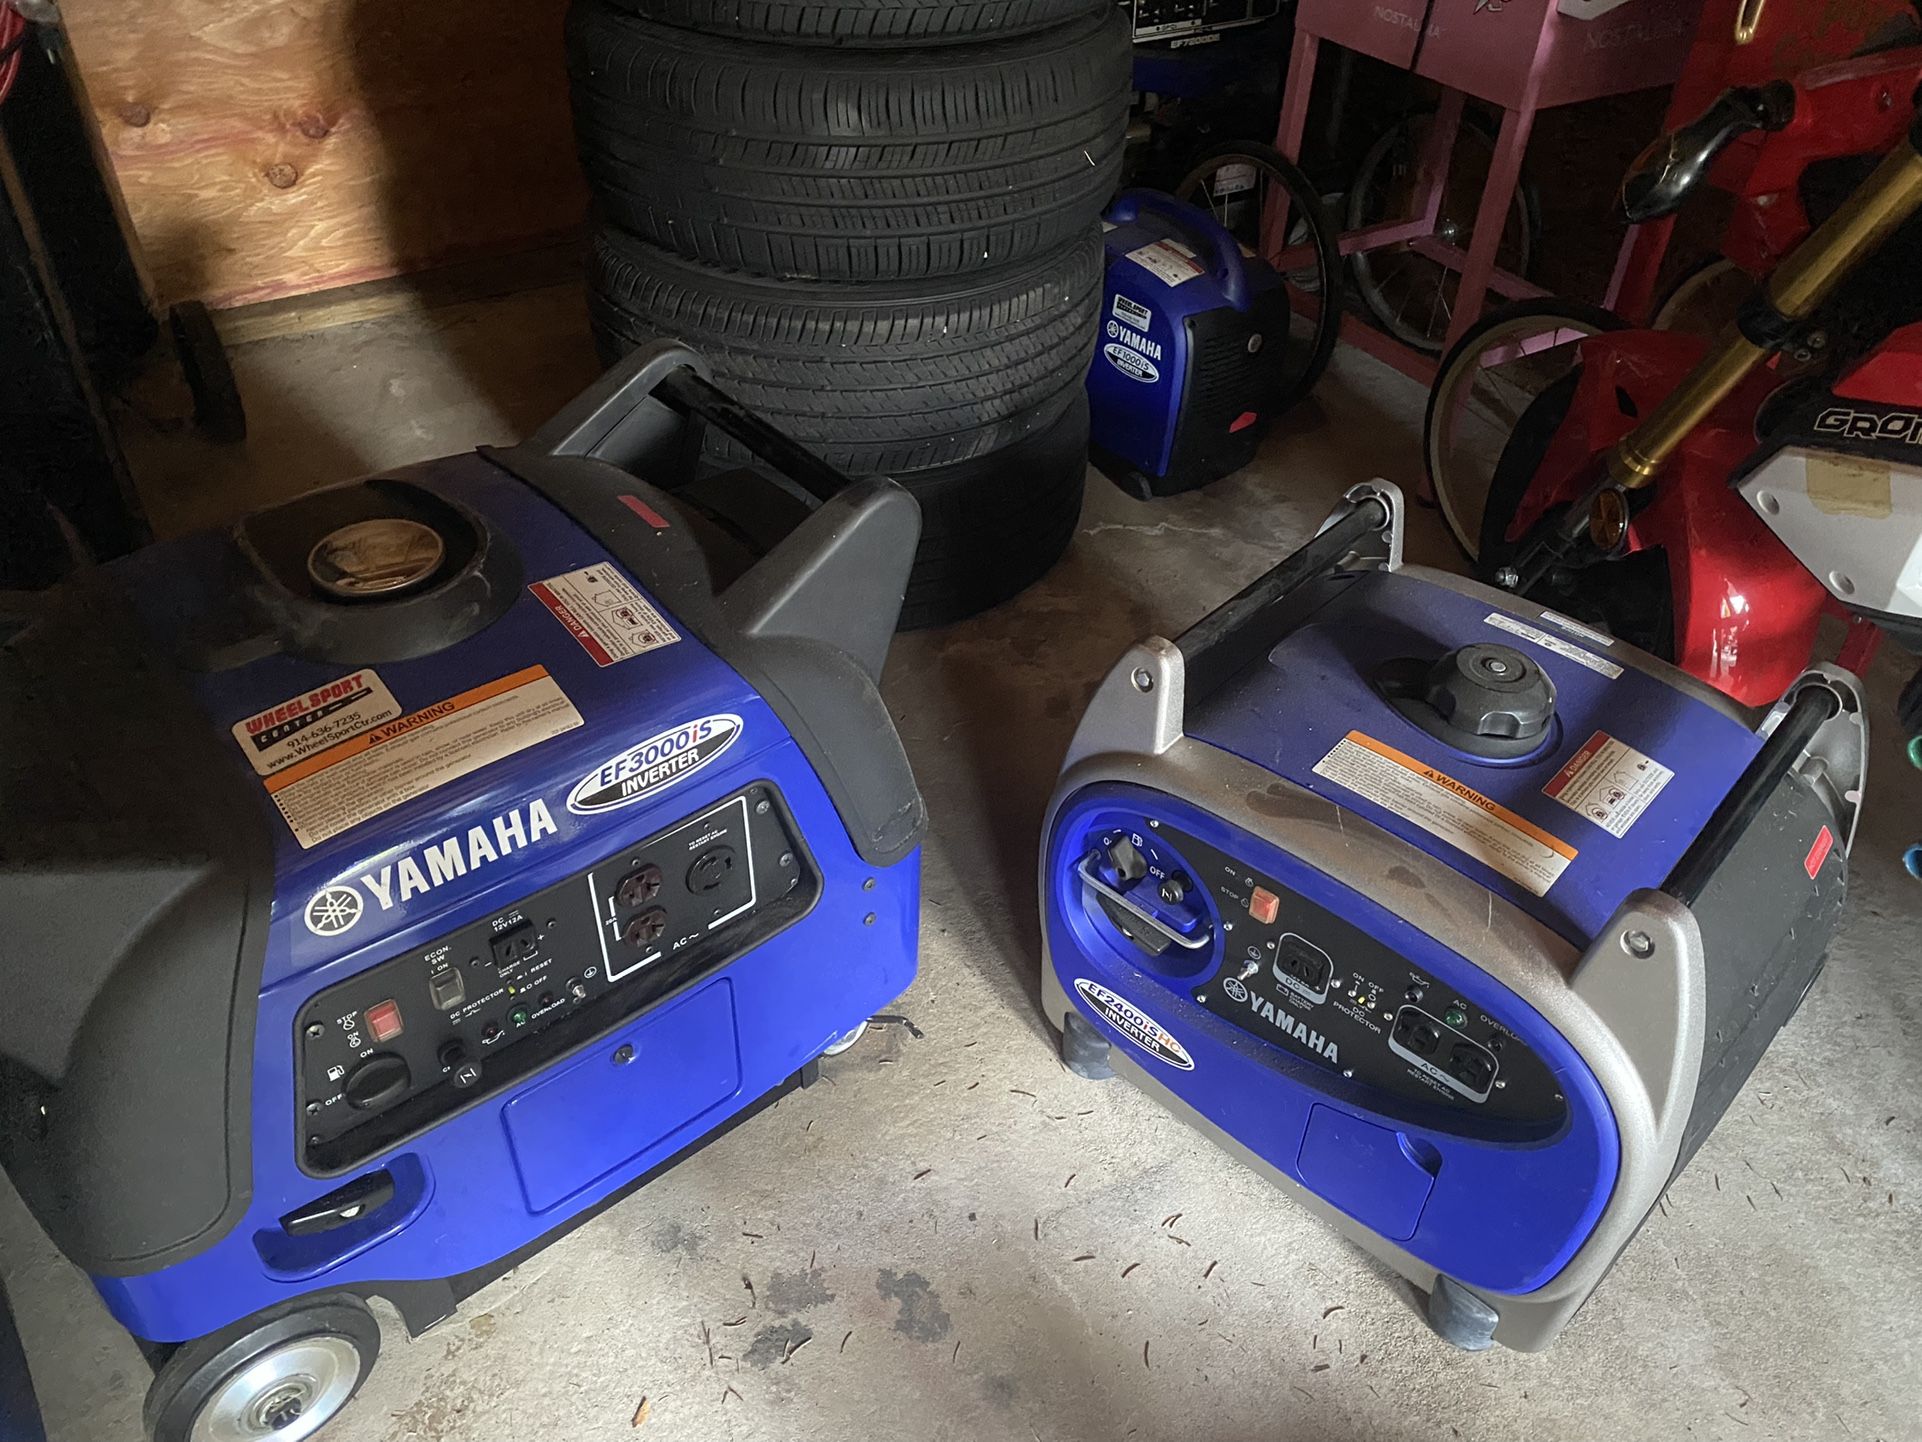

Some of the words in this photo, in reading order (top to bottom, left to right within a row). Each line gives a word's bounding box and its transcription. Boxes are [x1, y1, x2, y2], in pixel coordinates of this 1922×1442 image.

[1375, 6, 1440, 40] NOSTALIA
[1120, 326, 1161, 360] YAMAHA
[1113, 347, 1149, 370] EF1000iS
[1117, 359, 1143, 377] INVERTER
[554, 605, 580, 631] DANGER
[245, 698, 306, 734] WHEEL
[309, 674, 364, 709] SPORT
[260, 709, 327, 743] CENTER
[381, 701, 456, 738] WARNING
[287, 711, 361, 749] 914-636-7235
[267, 709, 393, 769] www.WheelSportCtr.com
[600, 720, 712, 786] EF3000iS
[621, 748, 699, 796] INVERTER
[1436, 774, 1497, 811] WARNING
[360, 798, 558, 910] YAMAHA
[1149, 866, 1166, 879] OFF
[1224, 866, 1236, 876] ON
[1220, 886, 1239, 899] STOP
[492, 917, 505, 927] DC
[672, 937, 687, 950] AC
[424, 945, 452, 962] ECON.
[431, 955, 445, 965] SW
[437, 963, 449, 971] ON
[498, 961, 521, 974] CHARGE
[530, 958, 553, 973] RESET
[499, 969, 514, 978] ONLY
[534, 975, 548, 986] OFF
[1352, 972, 1365, 982] ON
[1285, 978, 1300, 990] DC
[1368, 981, 1384, 993] OFF
[450, 1010, 461, 1020] DC
[463, 988, 504, 1013] PROTECTOR
[1352, 1006, 1365, 1017] DC
[1452, 999, 1467, 1010] AC
[336, 1011, 358, 1025] STOP
[1088, 984, 1181, 1053] EF2400iSHC
[1333, 1001, 1382, 1034] PROTECTOR
[347, 1031, 359, 1040] ON
[1105, 1007, 1160, 1052] INVERTER
[1249, 992, 1340, 1064] YAMAHA
[360, 1048, 374, 1058] ON
[1421, 1062, 1438, 1075] AC
[325, 1093, 343, 1106] OFF
